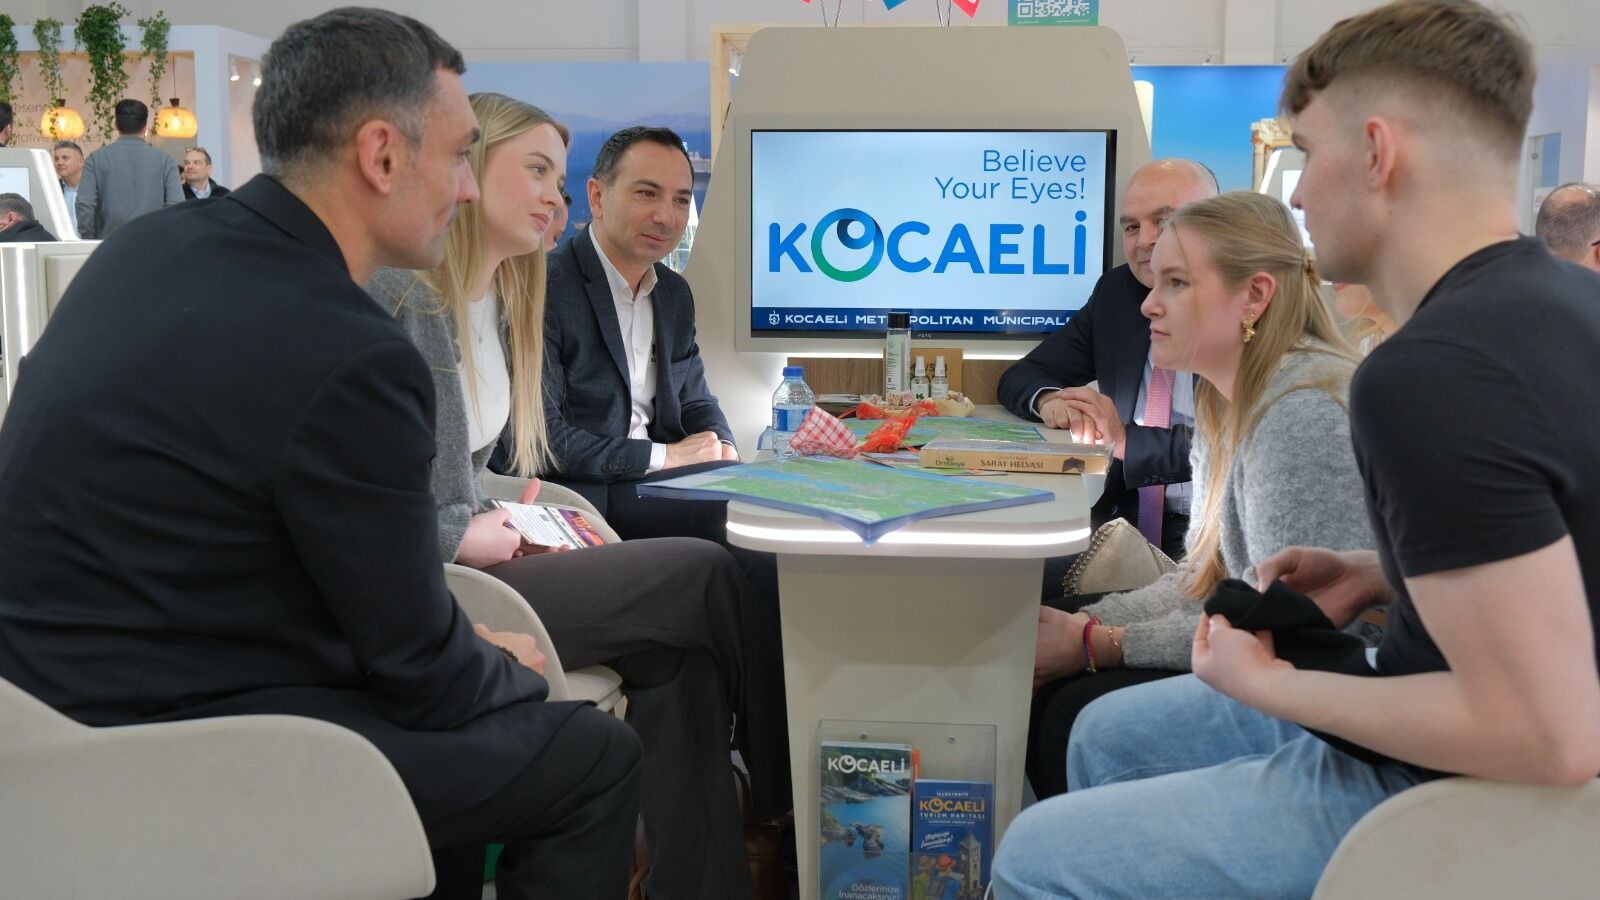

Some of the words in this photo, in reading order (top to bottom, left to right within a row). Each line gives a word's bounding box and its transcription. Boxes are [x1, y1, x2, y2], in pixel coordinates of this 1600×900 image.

[983, 149, 1087, 173] Believe
[935, 177, 1001, 200] Your
[1012, 177, 1086, 204] Eyes!
[855, 315, 974, 325] METPOLITAN
[980, 459, 1008, 468] SARAY
[1009, 460, 1044, 469] HELVASI
